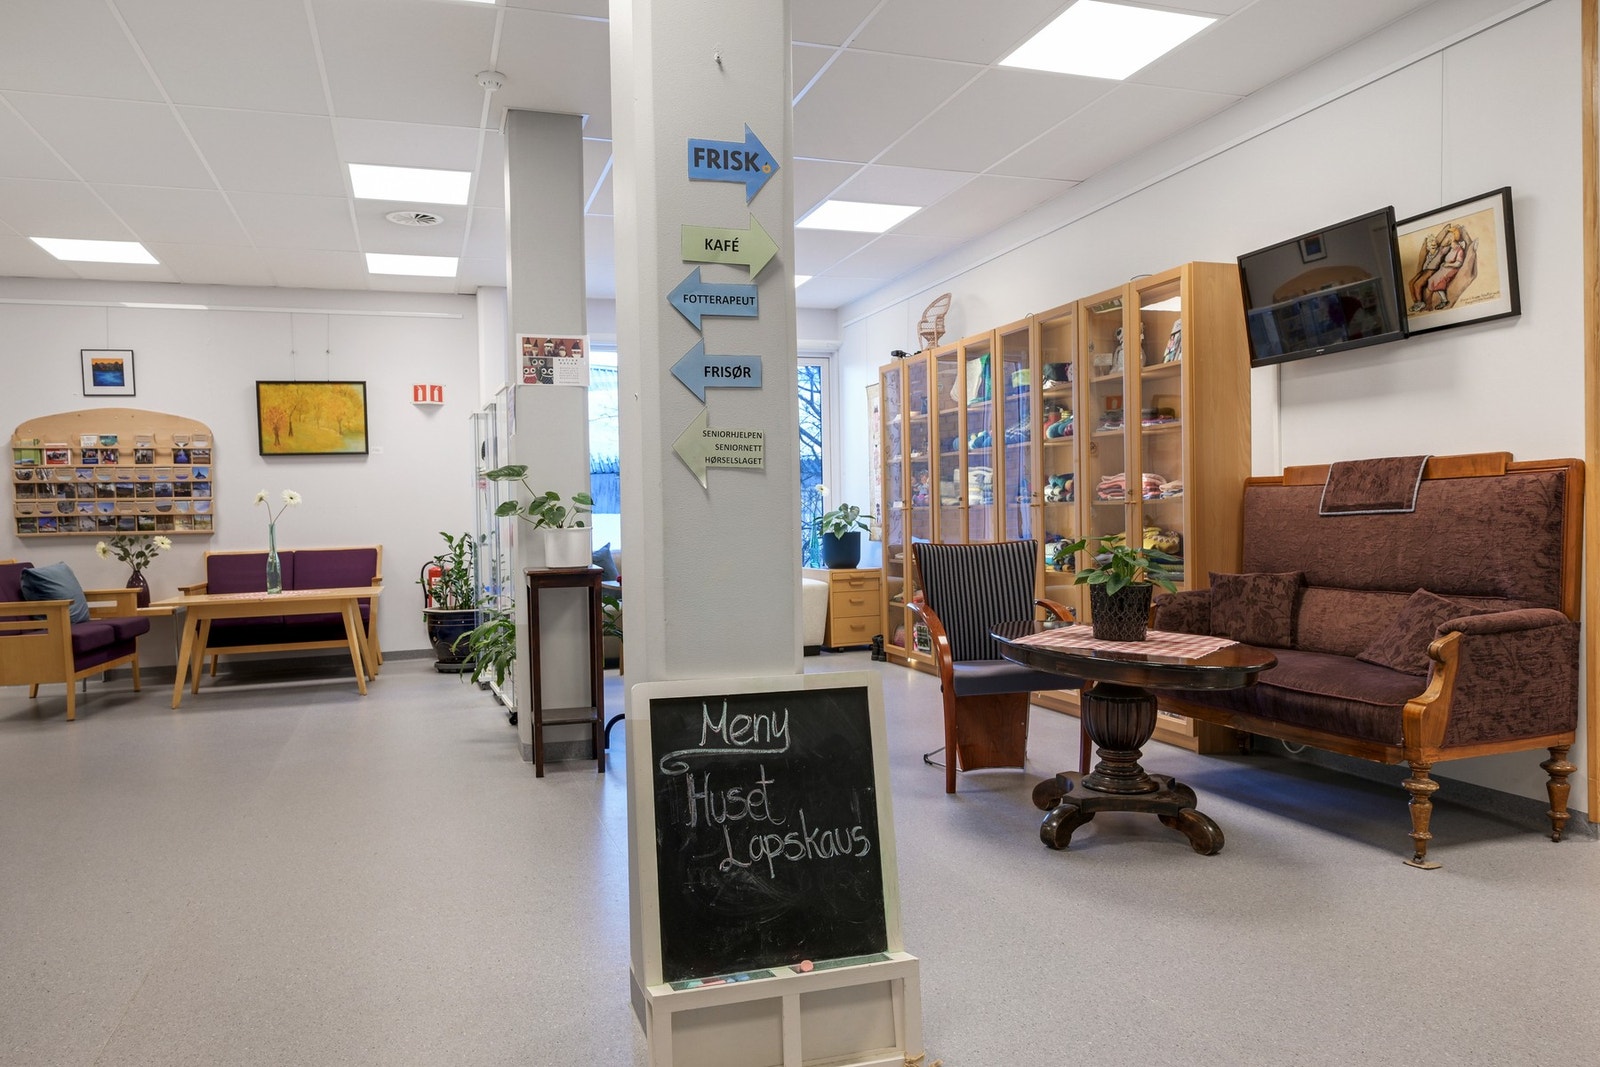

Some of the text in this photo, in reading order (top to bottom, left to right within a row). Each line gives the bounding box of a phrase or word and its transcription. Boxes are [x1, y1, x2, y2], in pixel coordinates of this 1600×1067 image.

[705, 237, 740, 252] KAFÉ
[683, 294, 756, 306] FOTTERAPEUT
[704, 365, 752, 379] FRISØR
[702, 429, 763, 439] SENIORHJELPEN
[715, 443, 762, 452] SENIORNETT
[705, 456, 762, 465] HØRSELSLAGET
[699, 699, 792, 753] Meny
[685, 764, 786, 827] Huset
[719, 809, 871, 879] Lapskaus
